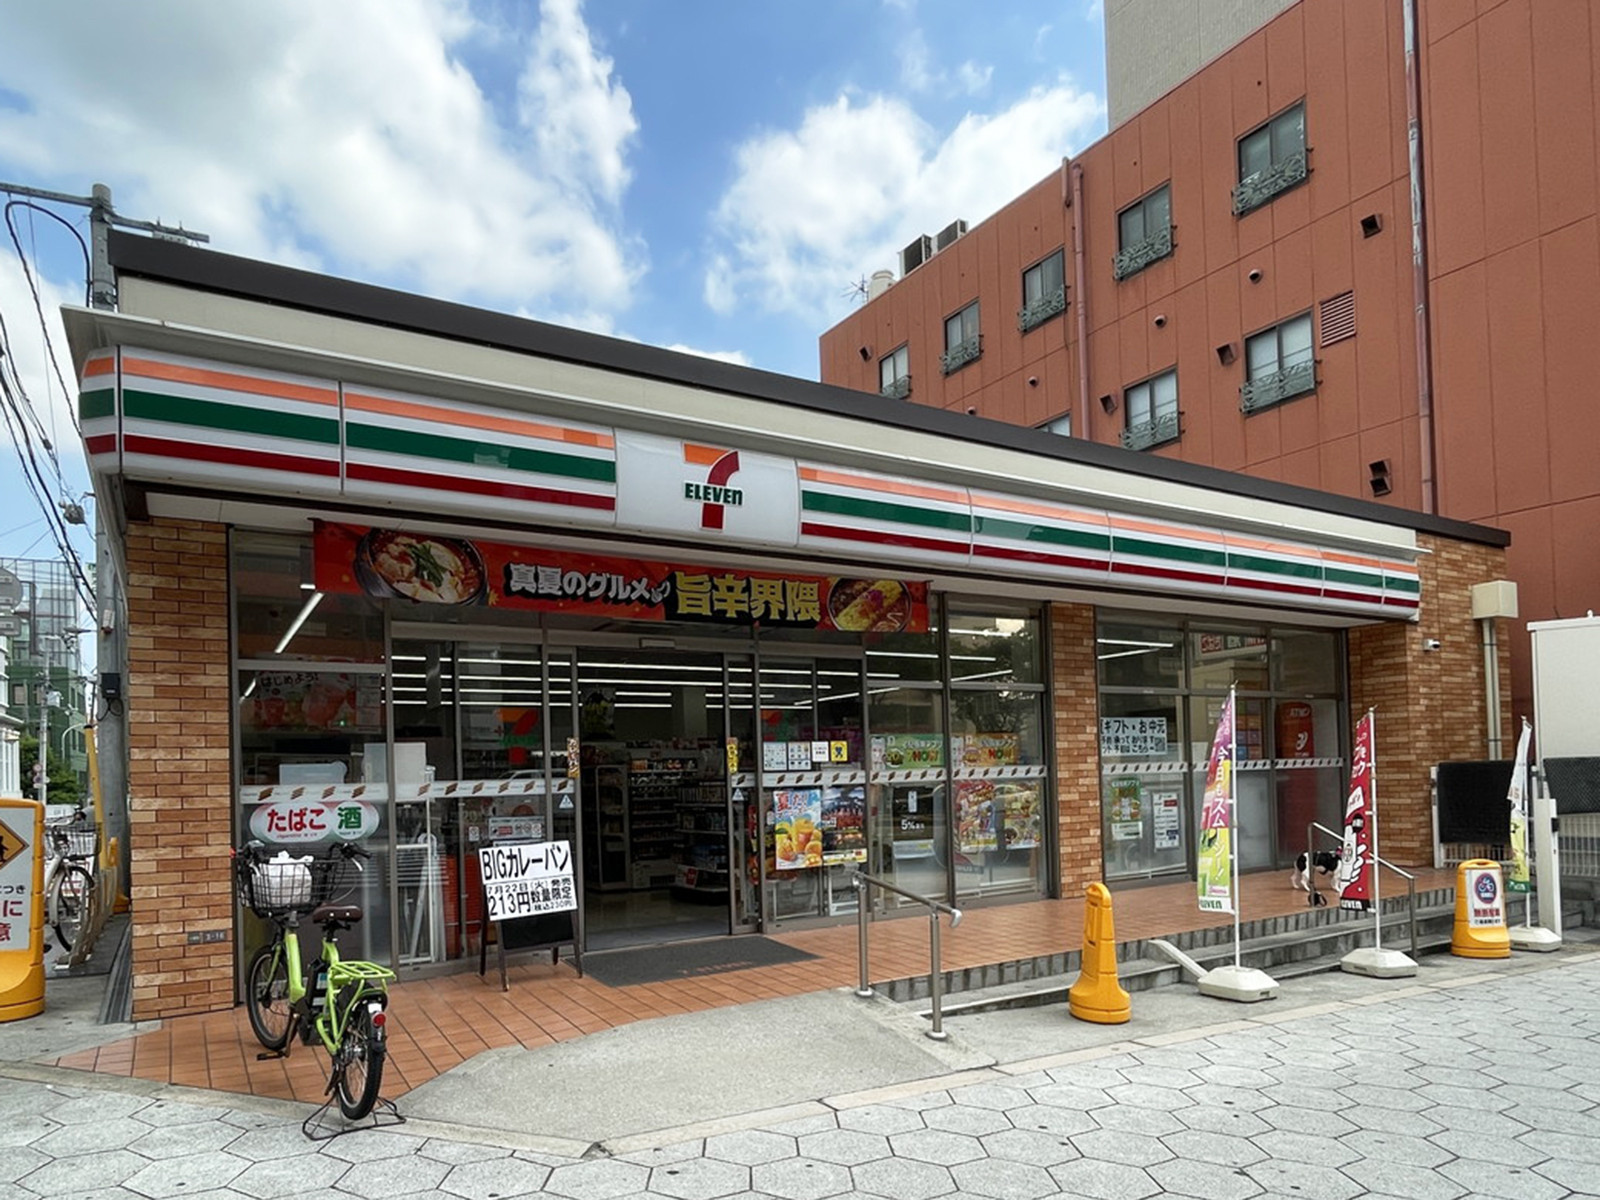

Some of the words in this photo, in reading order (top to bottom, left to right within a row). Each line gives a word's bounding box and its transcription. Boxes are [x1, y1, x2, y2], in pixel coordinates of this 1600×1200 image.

[684, 443, 740, 529] 7
[509, 563, 651, 602] 真夏のグルメ
[675, 571, 822, 622] 旨辛界隈
[267, 807, 327, 832] たばこ
[337, 806, 362, 829] 酒
[482, 844, 569, 880] BIGカレーパン
[3, 900, 23, 917] に
[488, 891, 531, 916] 213円
